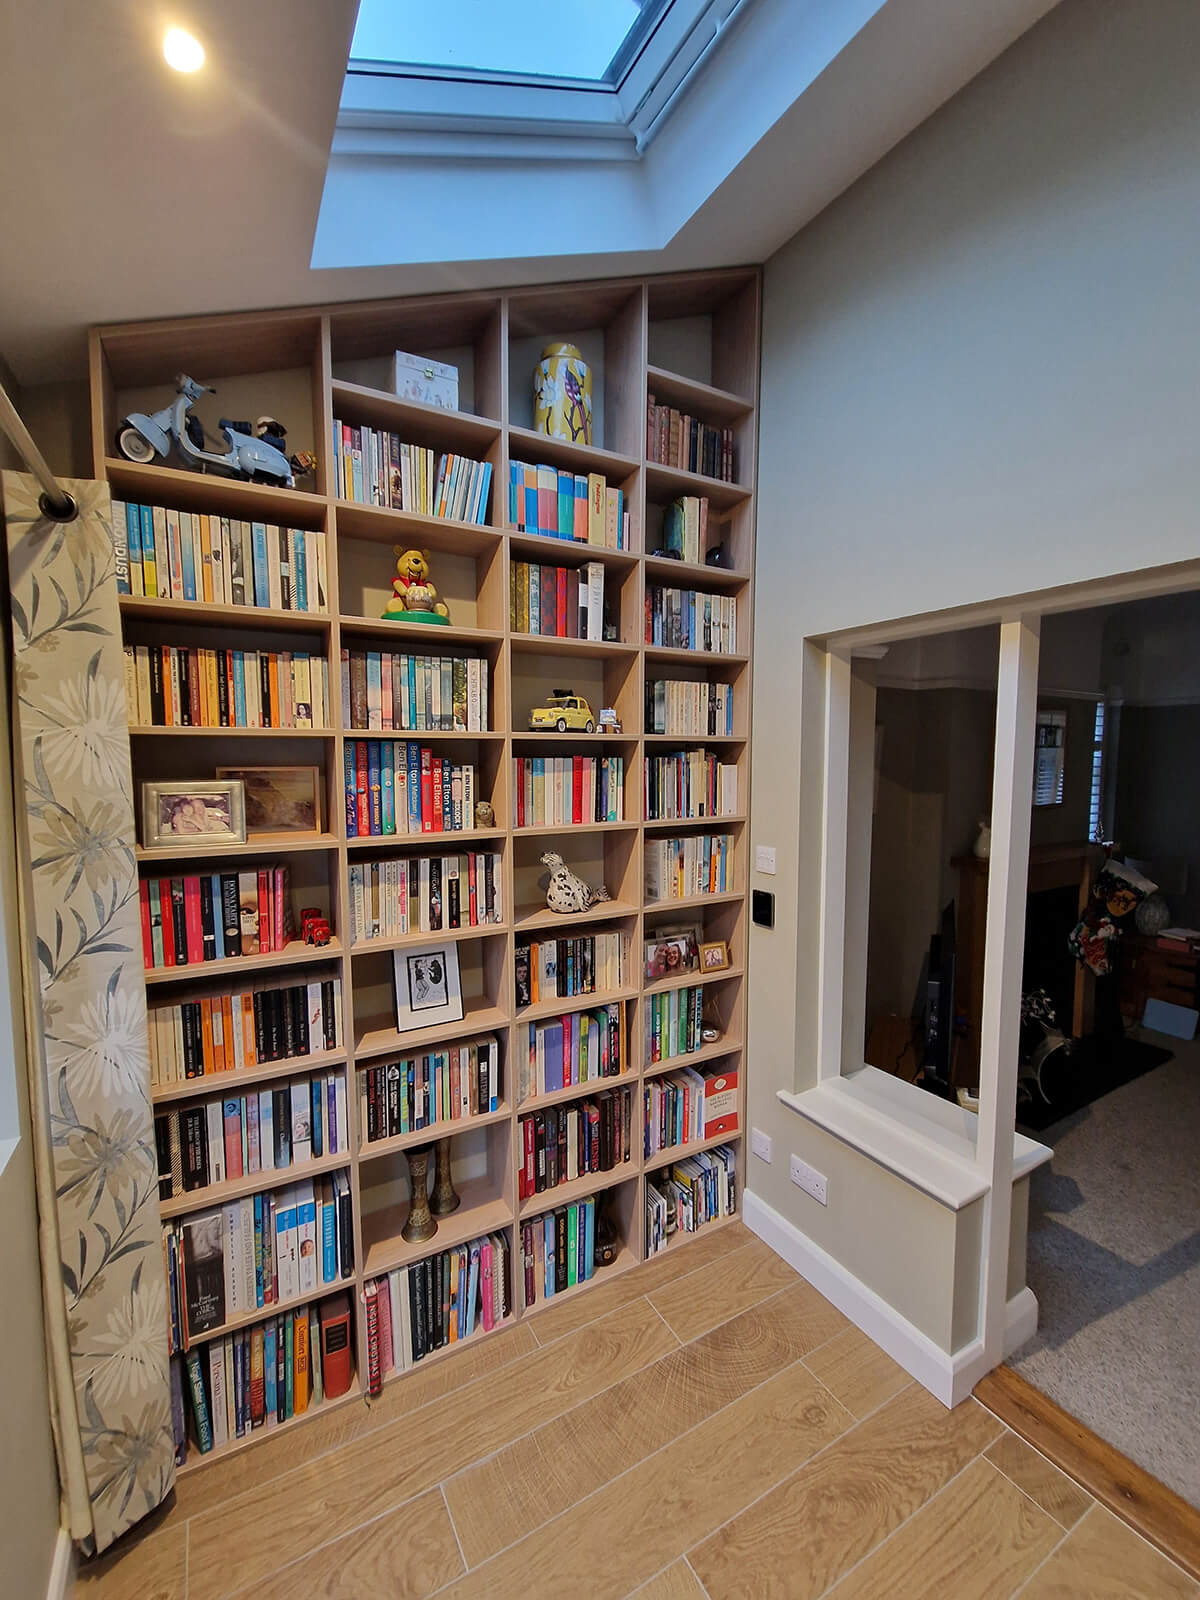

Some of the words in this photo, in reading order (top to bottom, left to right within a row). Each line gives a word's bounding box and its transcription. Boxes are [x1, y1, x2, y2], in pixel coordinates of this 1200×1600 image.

[594, 482, 602, 515] Paddington
[399, 745, 408, 761] Ben
[410, 745, 418, 760] Ben
[411, 762, 420, 784] Elton
[434, 784, 442, 805] Elton
[443, 784, 451, 805] Elton
[368, 1303, 379, 1334] NIGELLA
[297, 1324, 307, 1355] Comfort
[369, 1335, 381, 1377] CHRISTMAS
[189, 1361, 201, 1382] Nigel
